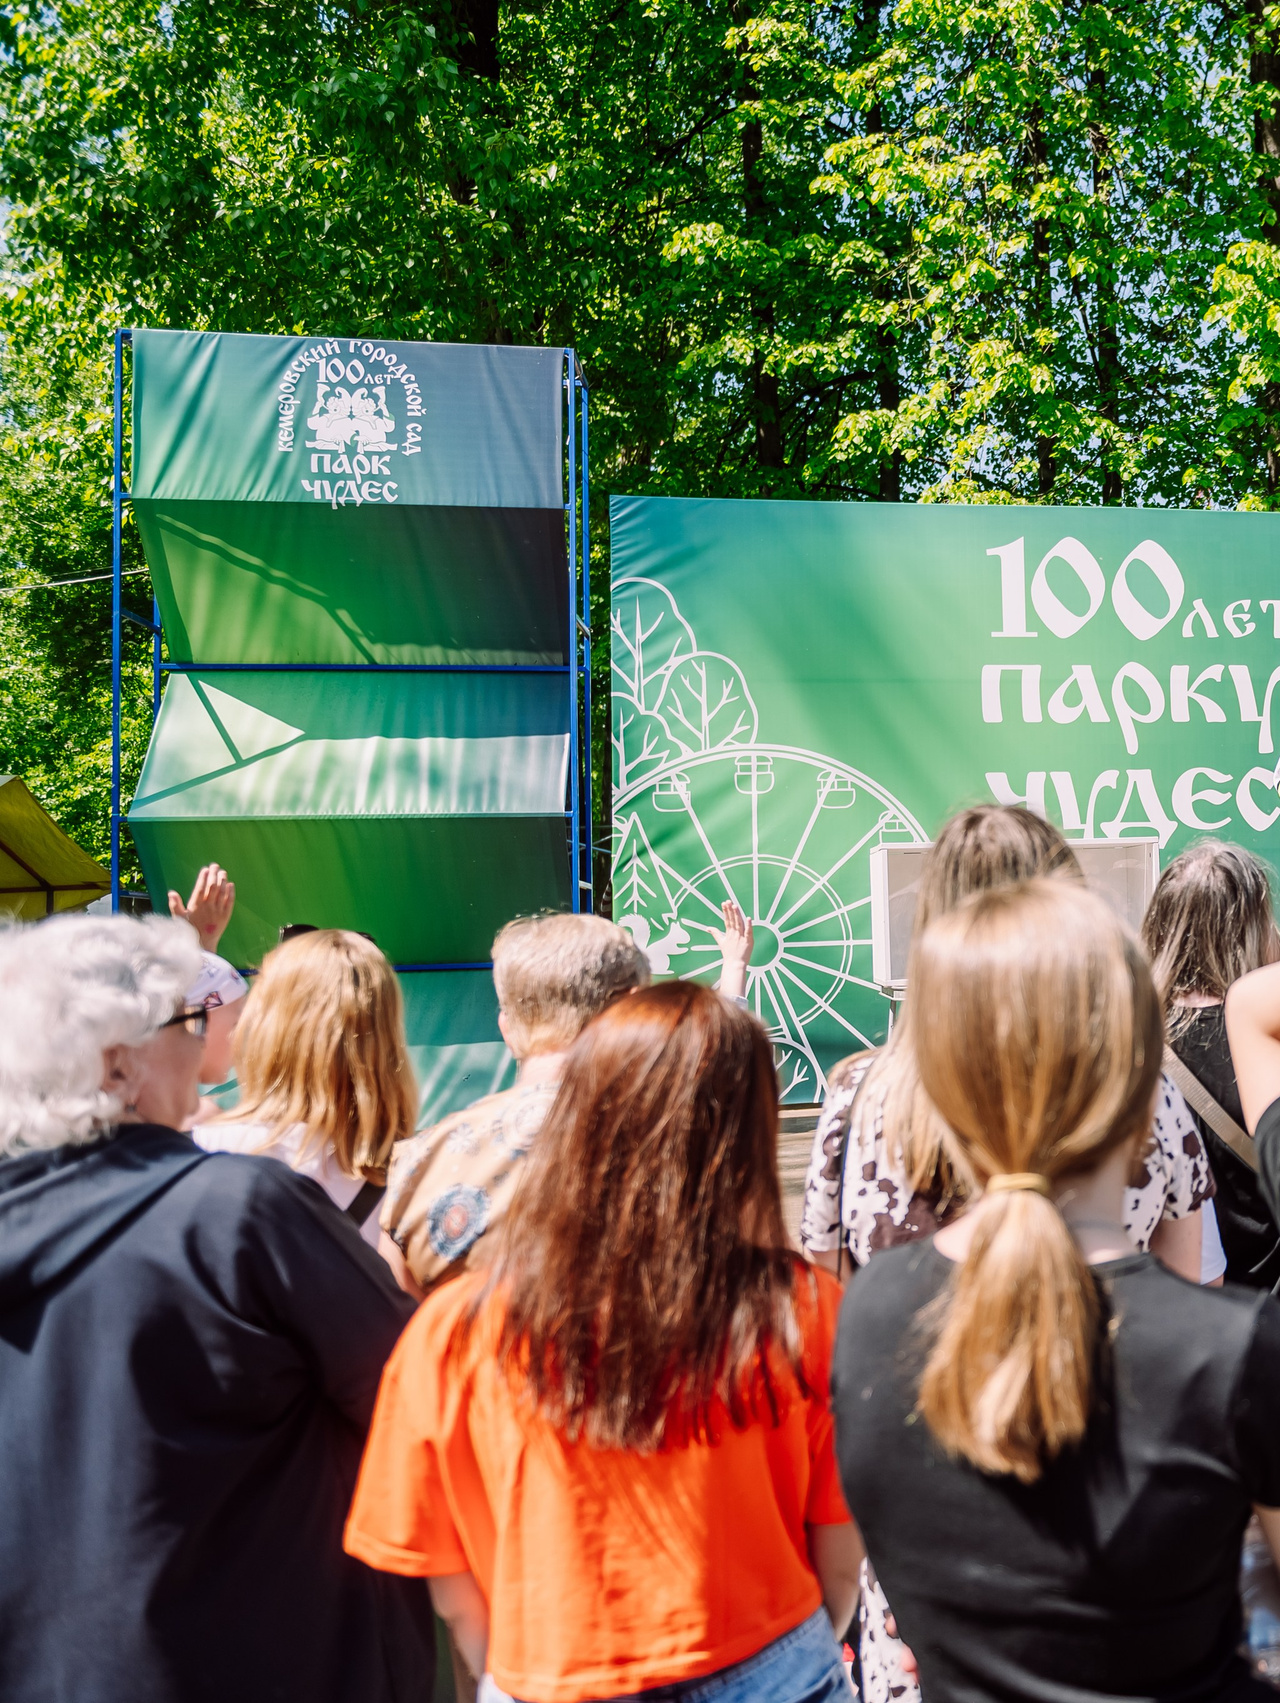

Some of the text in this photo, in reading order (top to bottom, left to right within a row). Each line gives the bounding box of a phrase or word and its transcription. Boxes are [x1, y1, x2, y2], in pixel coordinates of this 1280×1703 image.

[315, 358, 365, 384] 100
[311, 453, 391, 484] ПАРК
[301, 480, 398, 510] ЧУДЕС
[985, 536, 1185, 641] 100
